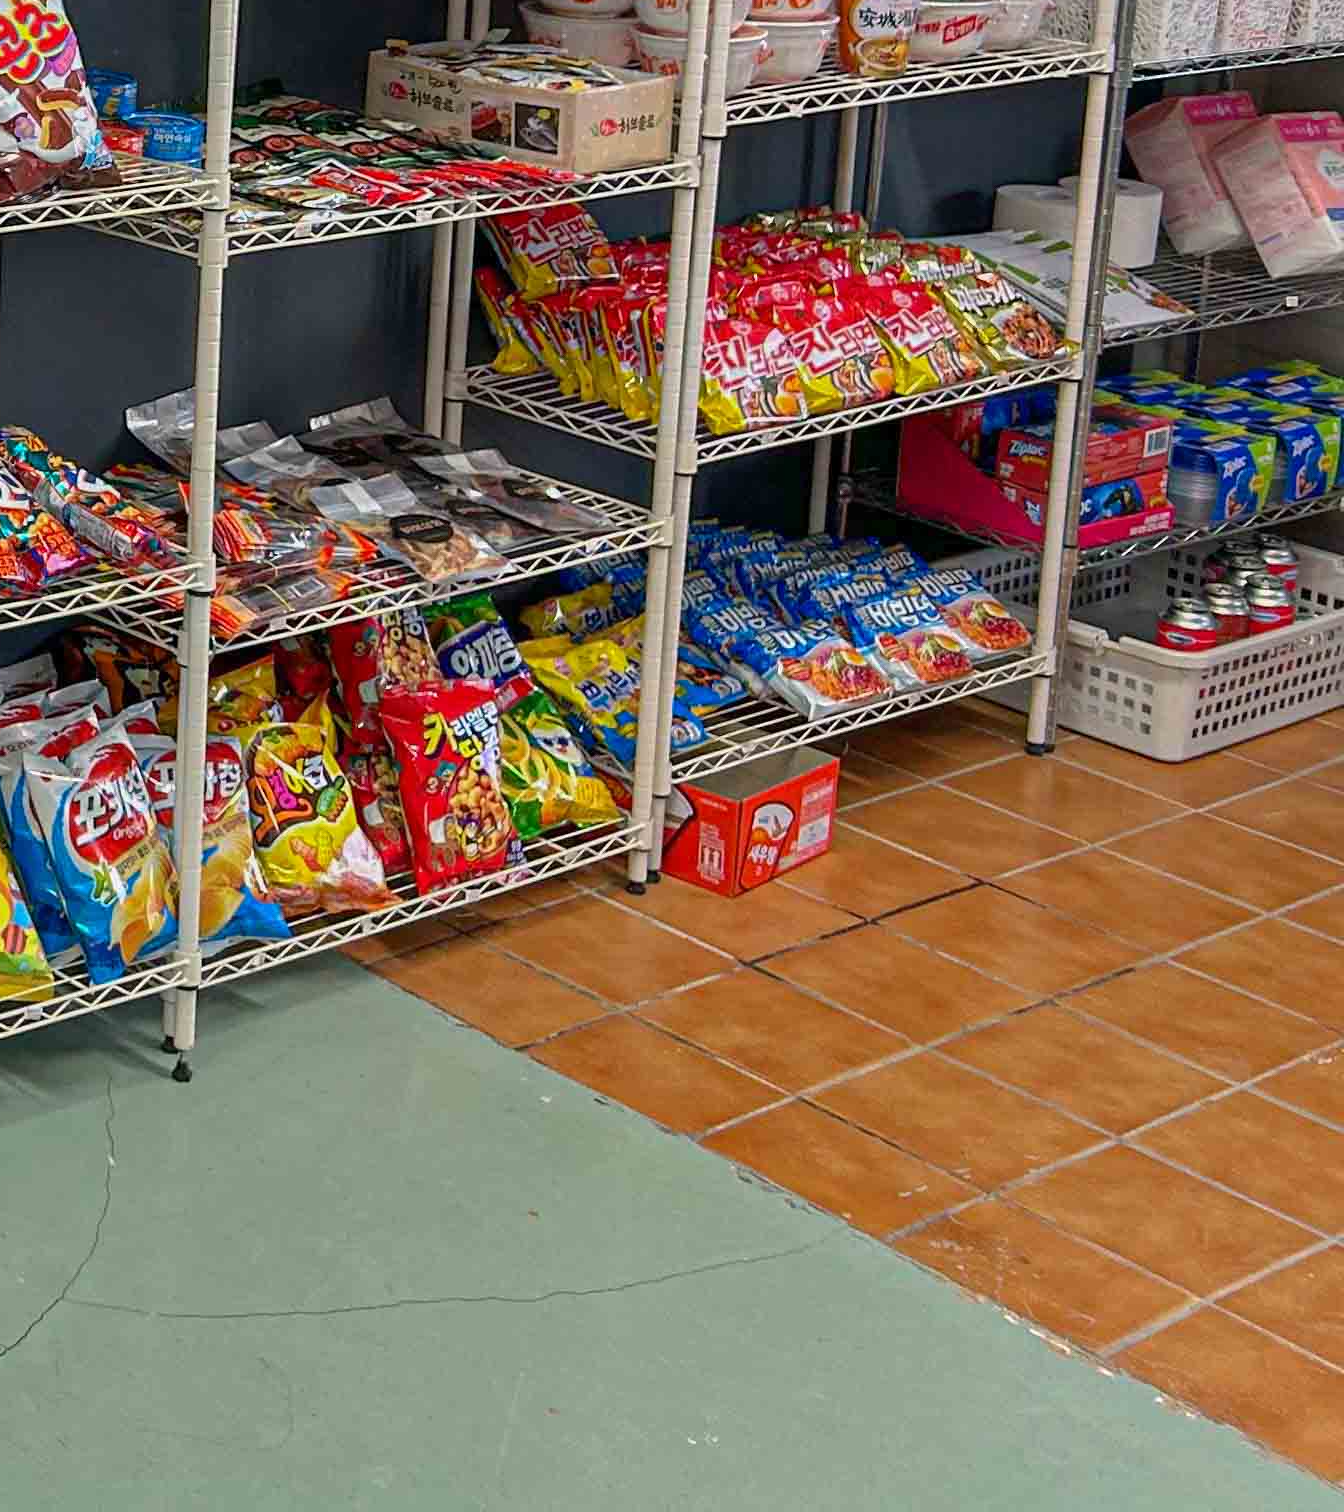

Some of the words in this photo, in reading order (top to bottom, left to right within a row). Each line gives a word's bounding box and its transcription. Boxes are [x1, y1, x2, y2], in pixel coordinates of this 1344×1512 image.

[510, 213, 600, 264] 진라면
[789, 314, 877, 375] 진라면
[883, 306, 955, 357] 진라면
